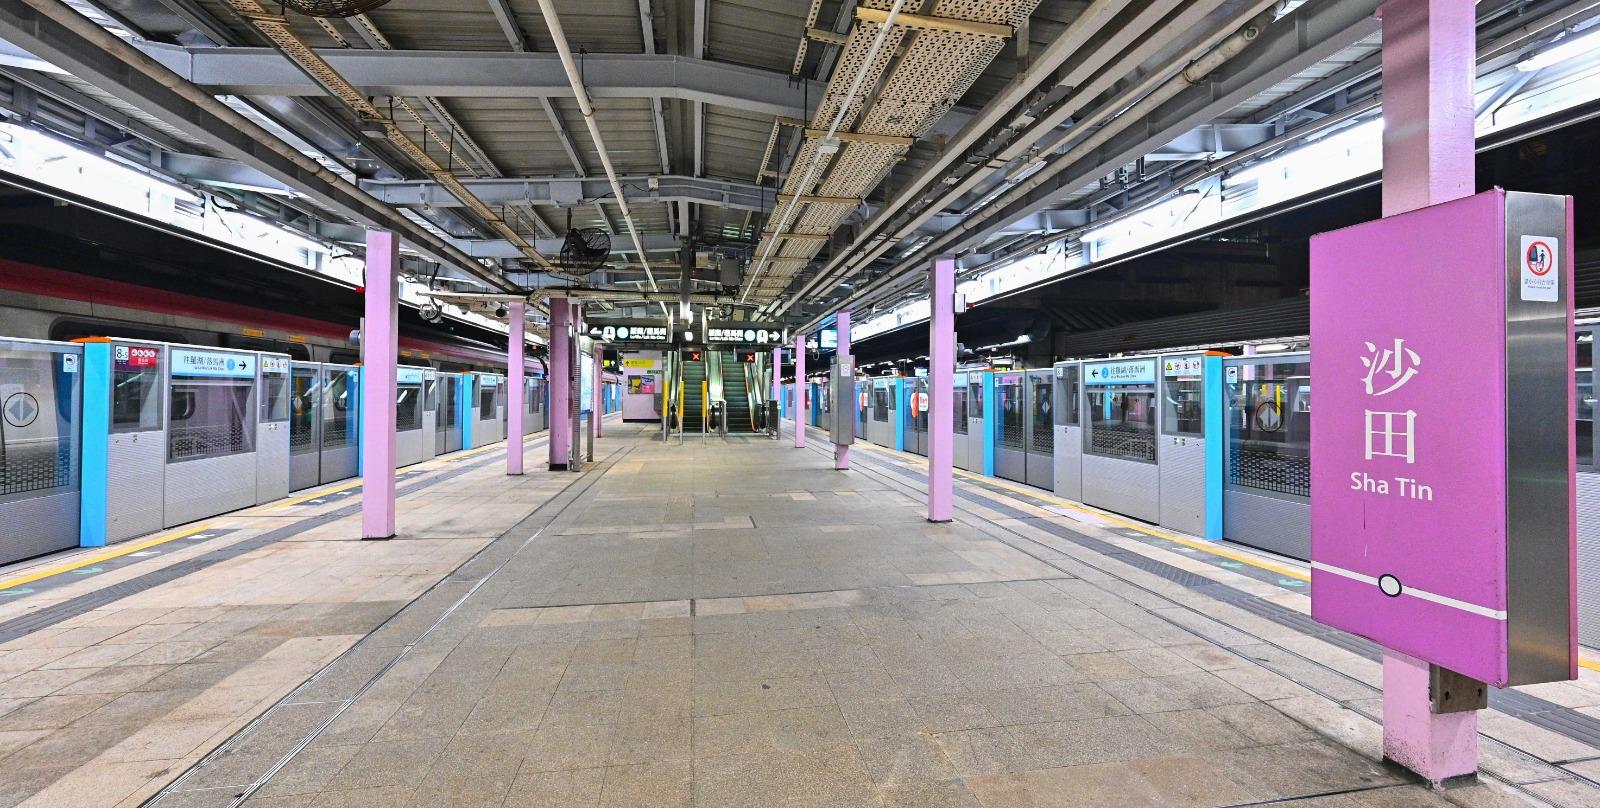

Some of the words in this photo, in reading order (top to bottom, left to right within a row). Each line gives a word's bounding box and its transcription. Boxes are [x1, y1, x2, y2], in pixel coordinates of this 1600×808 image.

[1360, 339, 1420, 464] 沙田
[1351, 472, 1388, 494] Sha
[1395, 478, 1432, 501] Tin
